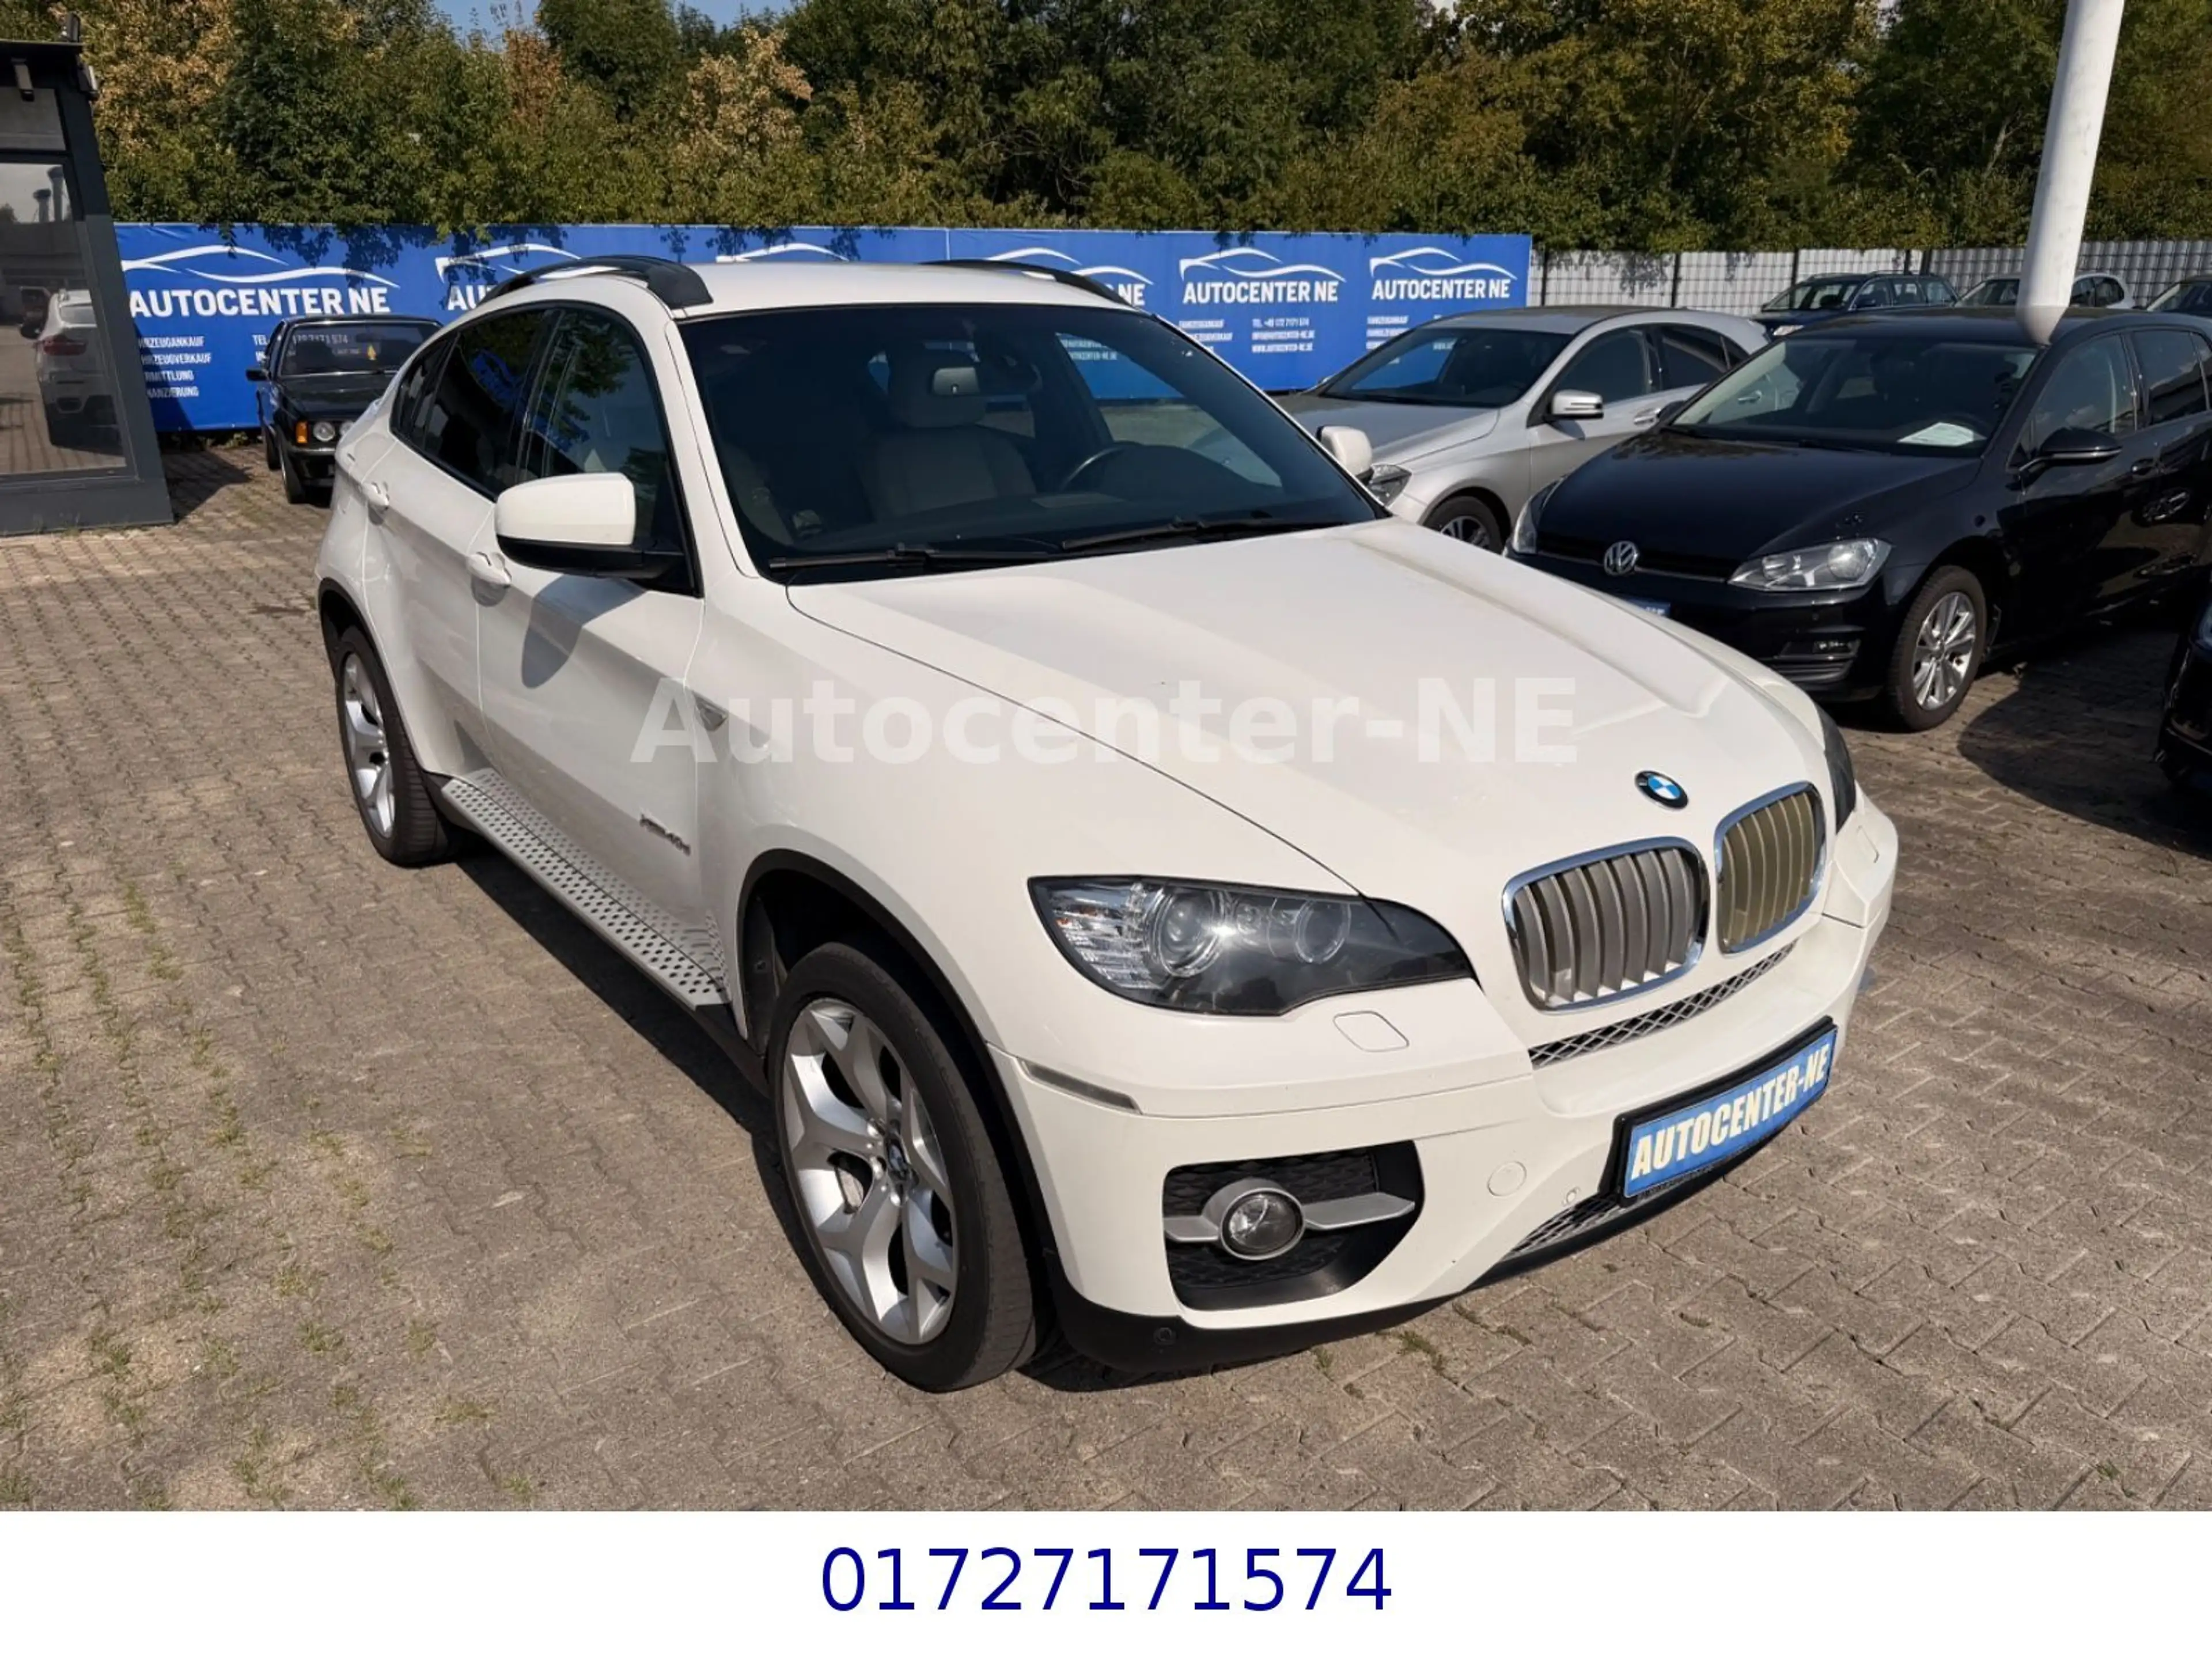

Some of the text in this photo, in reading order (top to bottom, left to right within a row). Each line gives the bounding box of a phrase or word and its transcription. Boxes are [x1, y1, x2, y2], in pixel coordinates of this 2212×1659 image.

[130, 287, 391, 317] AUTOCENTER NE
[1183, 281, 1338, 304] AUTOCENTER NE
[1372, 279, 1511, 300] AUTOCENTER NE
[1631, 1044, 1830, 1180] AUTOCENTER-NE
